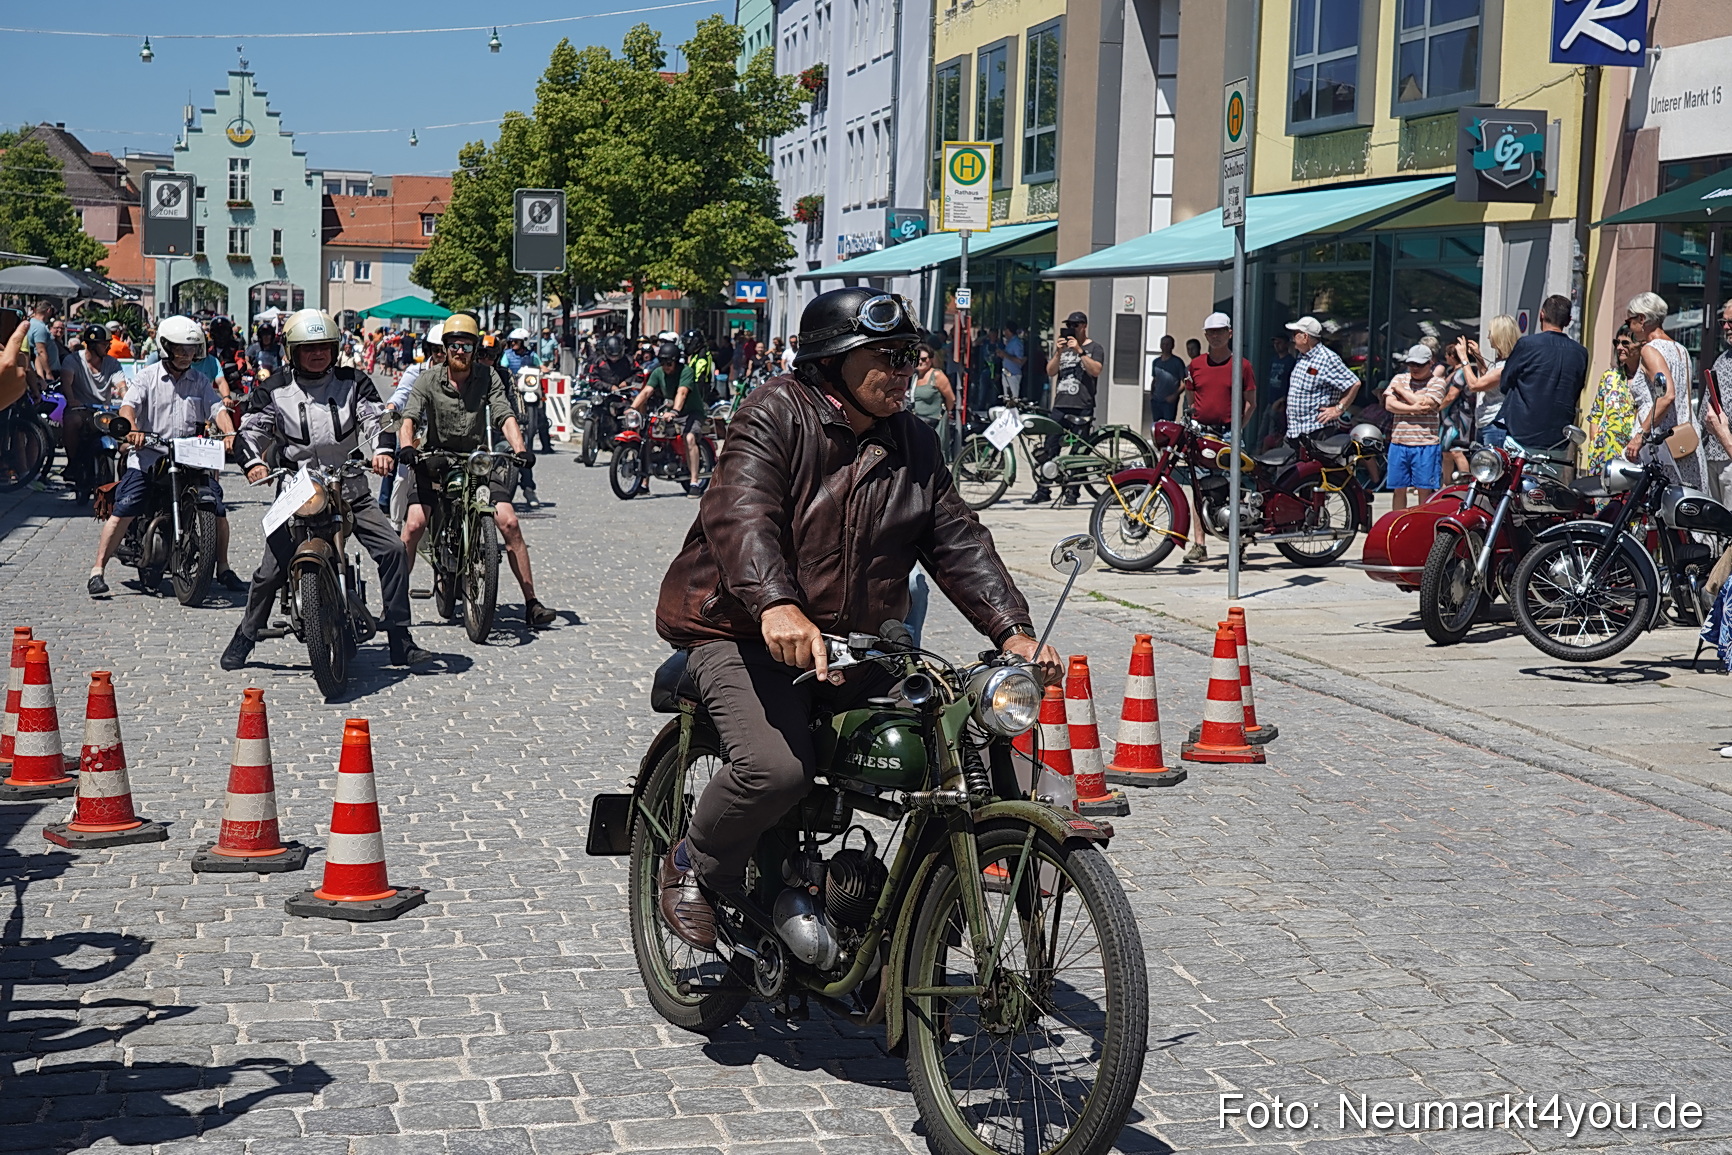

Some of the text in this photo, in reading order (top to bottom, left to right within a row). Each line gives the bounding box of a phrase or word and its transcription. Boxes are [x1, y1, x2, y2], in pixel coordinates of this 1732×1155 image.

[1651, 86, 1722, 114] Unterer Markt 15
[960, 156, 975, 177] H
[1494, 134, 1525, 173] G2
[900, 220, 917, 239] G2
[913, 1066, 948, 1141] EXTRA PRIMA
